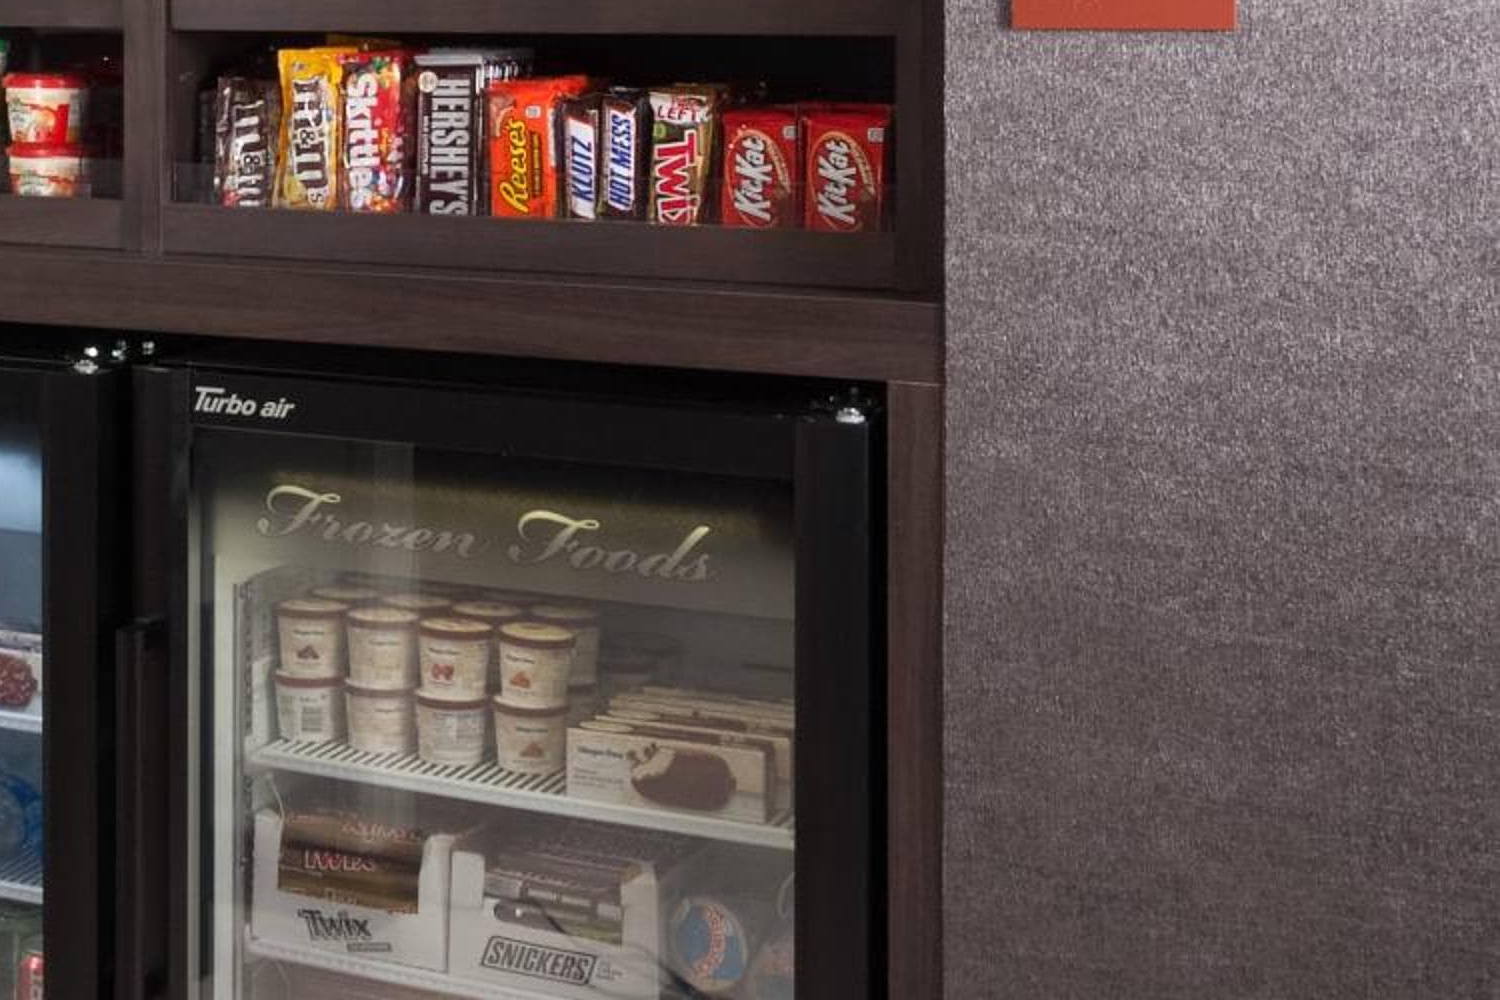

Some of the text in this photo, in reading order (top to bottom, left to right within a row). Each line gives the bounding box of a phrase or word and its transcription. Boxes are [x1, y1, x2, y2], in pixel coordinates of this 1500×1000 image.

[346, 72, 380, 210] Skittles
[429, 78, 470, 216] HERSHEY'S
[656, 104, 698, 121] LEFT
[499, 118, 529, 213] Reese's
[571, 136, 594, 203] KLUTZ
[609, 114, 632, 207] HOT MESS
[193, 387, 296, 420] Turbo air
[256, 484, 717, 581] Frozen Foods
[298, 908, 372, 940] Twix
[489, 941, 591, 981] SNICKERS
